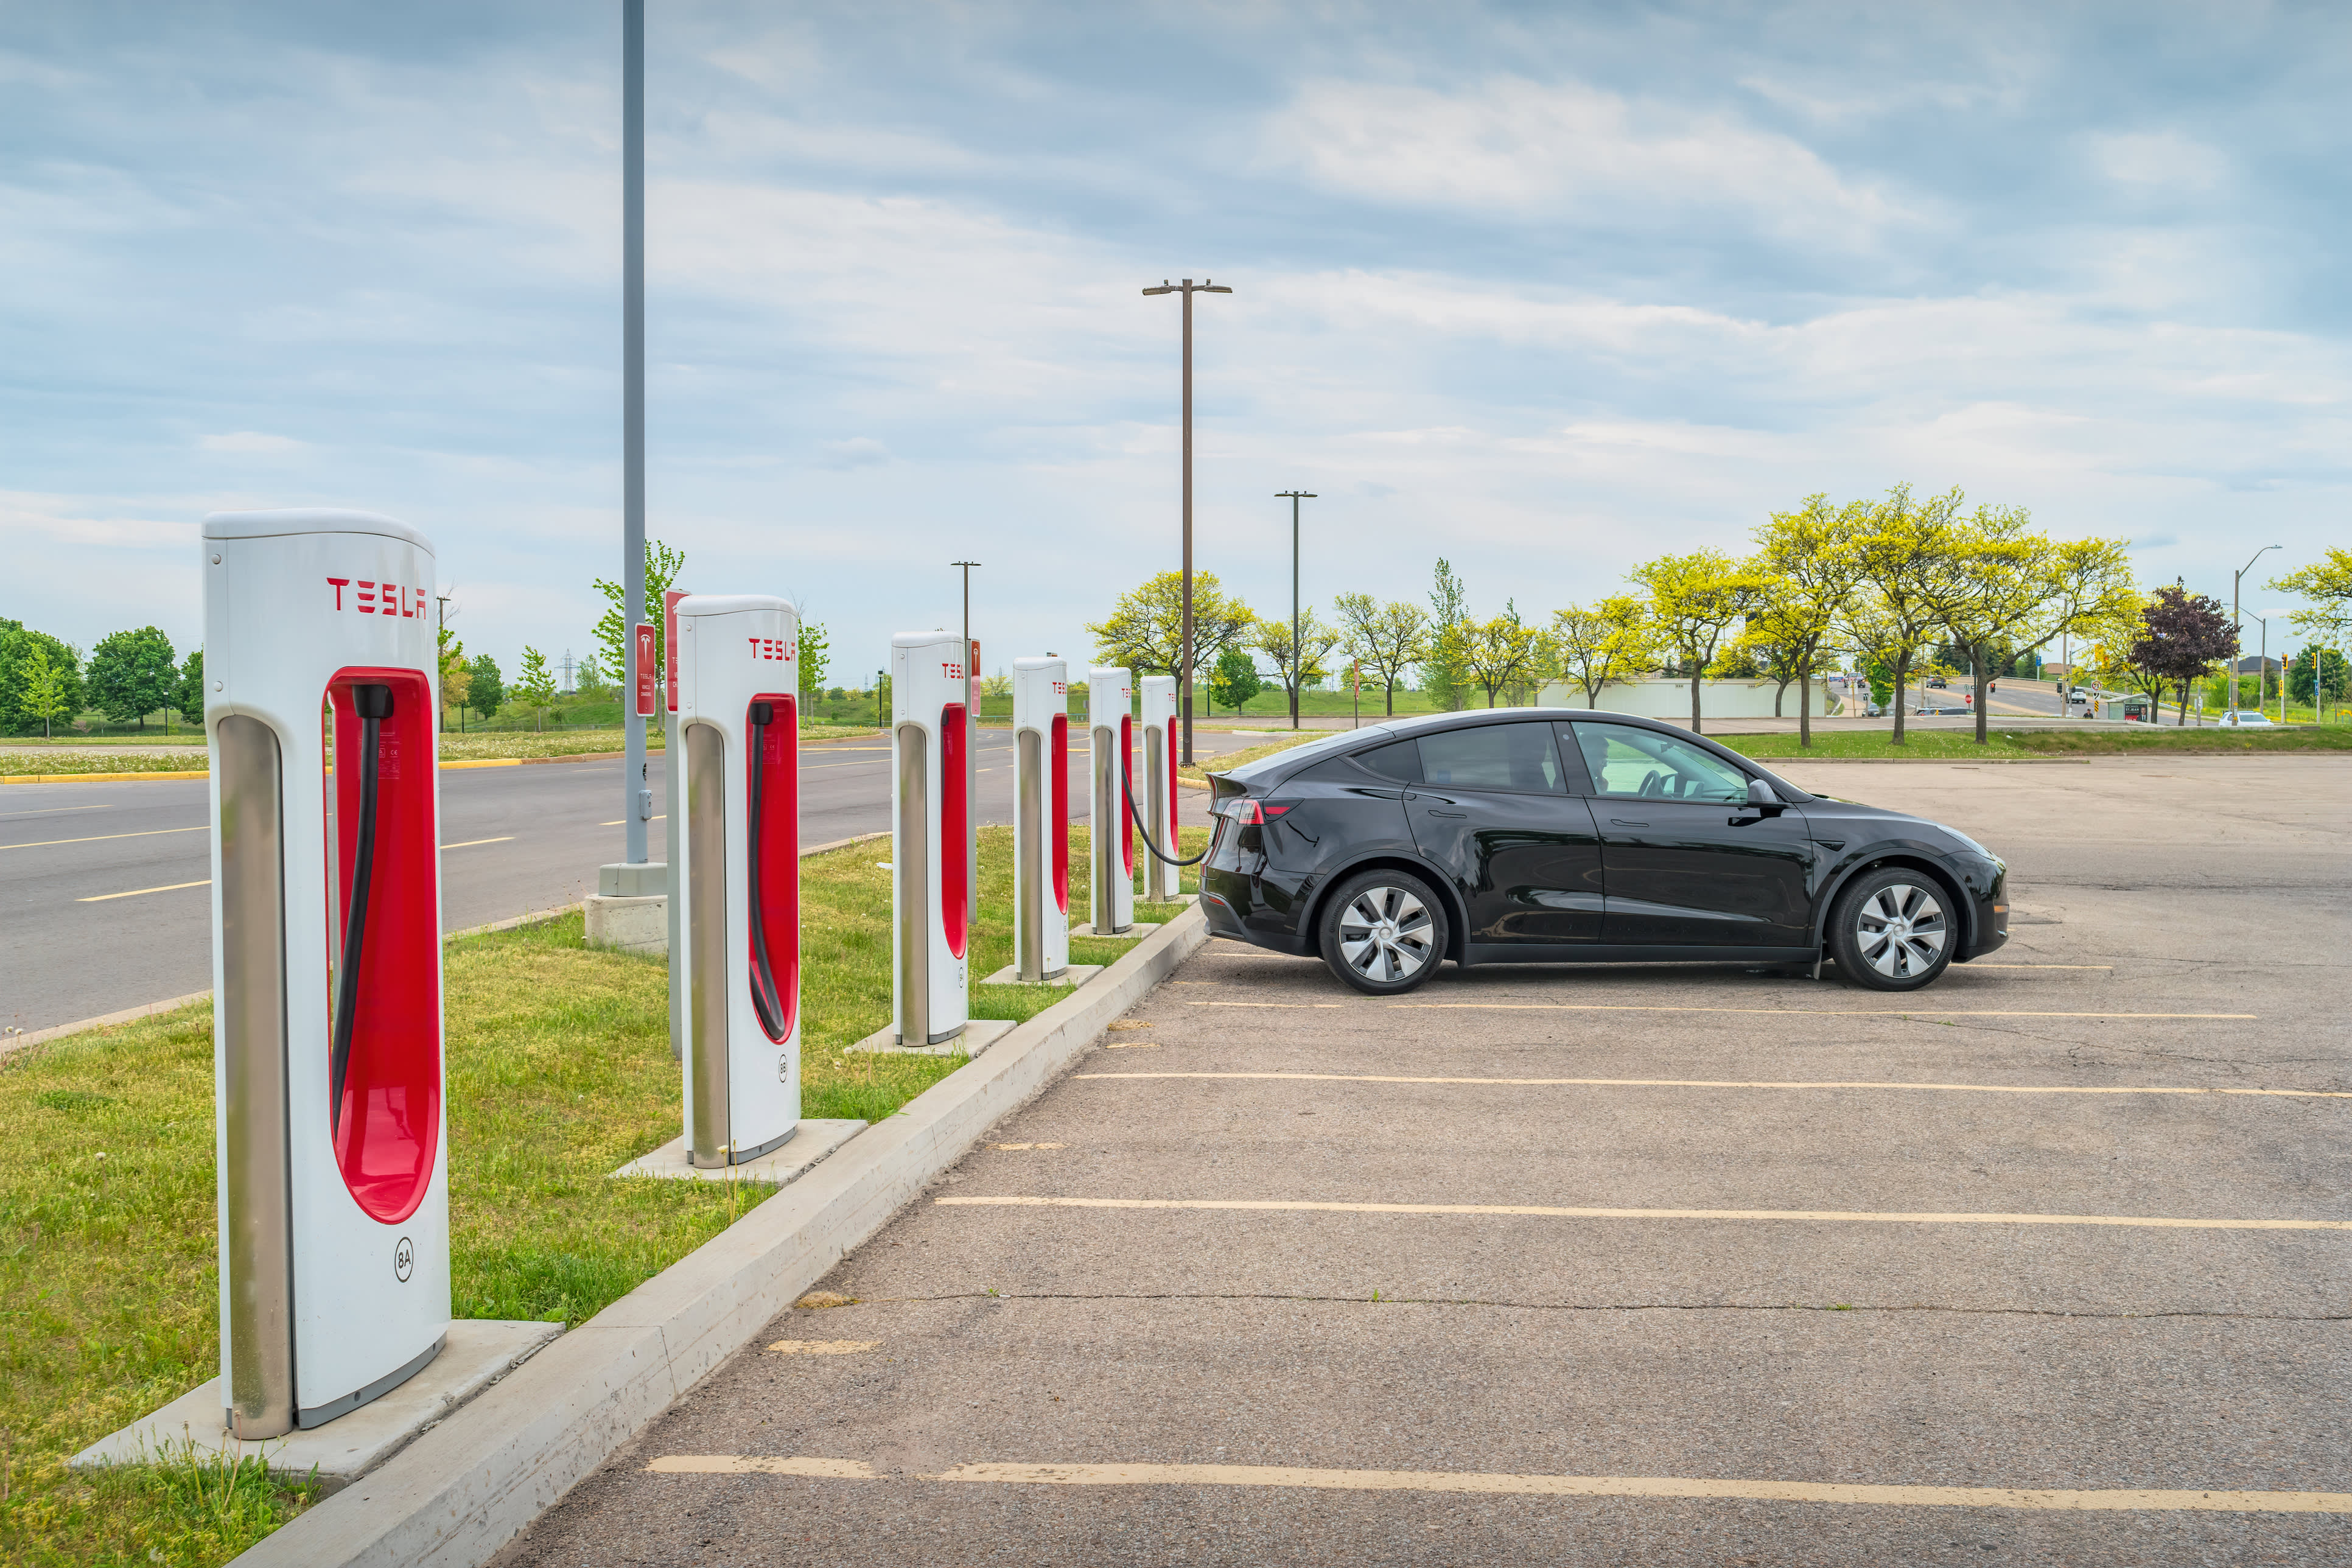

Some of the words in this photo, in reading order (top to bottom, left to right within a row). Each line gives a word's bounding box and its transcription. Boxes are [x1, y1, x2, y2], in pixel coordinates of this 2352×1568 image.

[326, 577, 426, 620] TESLA
[748, 638, 795, 662] TESLA
[942, 663, 964, 679] TESL
[1052, 682, 1066, 695] TES
[398, 1249, 411, 1269] 8A
